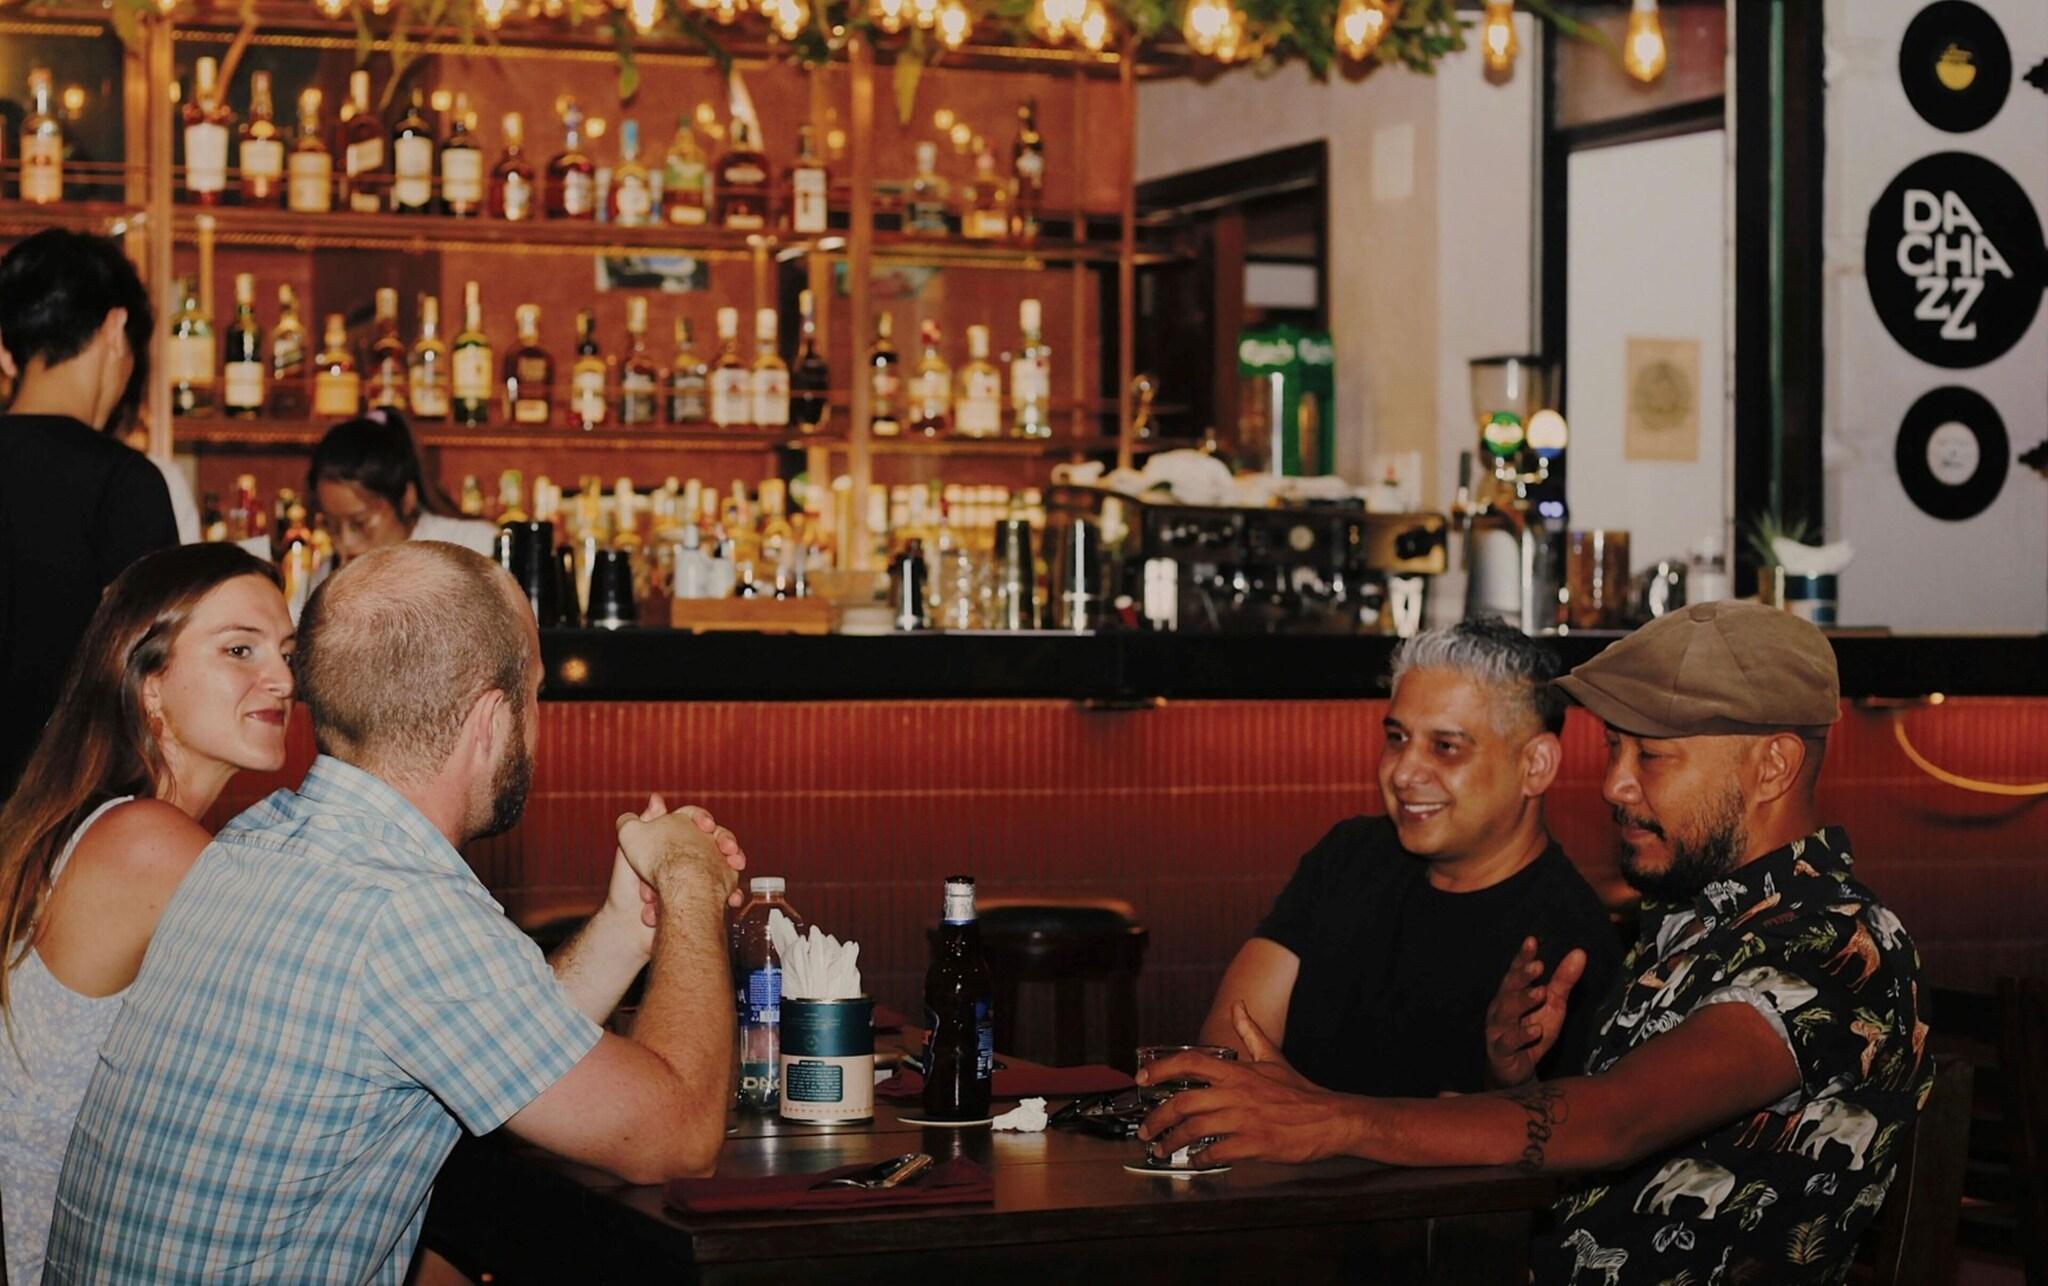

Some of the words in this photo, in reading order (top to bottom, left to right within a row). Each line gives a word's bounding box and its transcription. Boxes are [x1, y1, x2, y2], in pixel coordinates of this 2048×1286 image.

[1903, 189, 1983, 235] DA
[1896, 232, 2014, 279] CHA
[1914, 276, 1984, 340] ZZ
